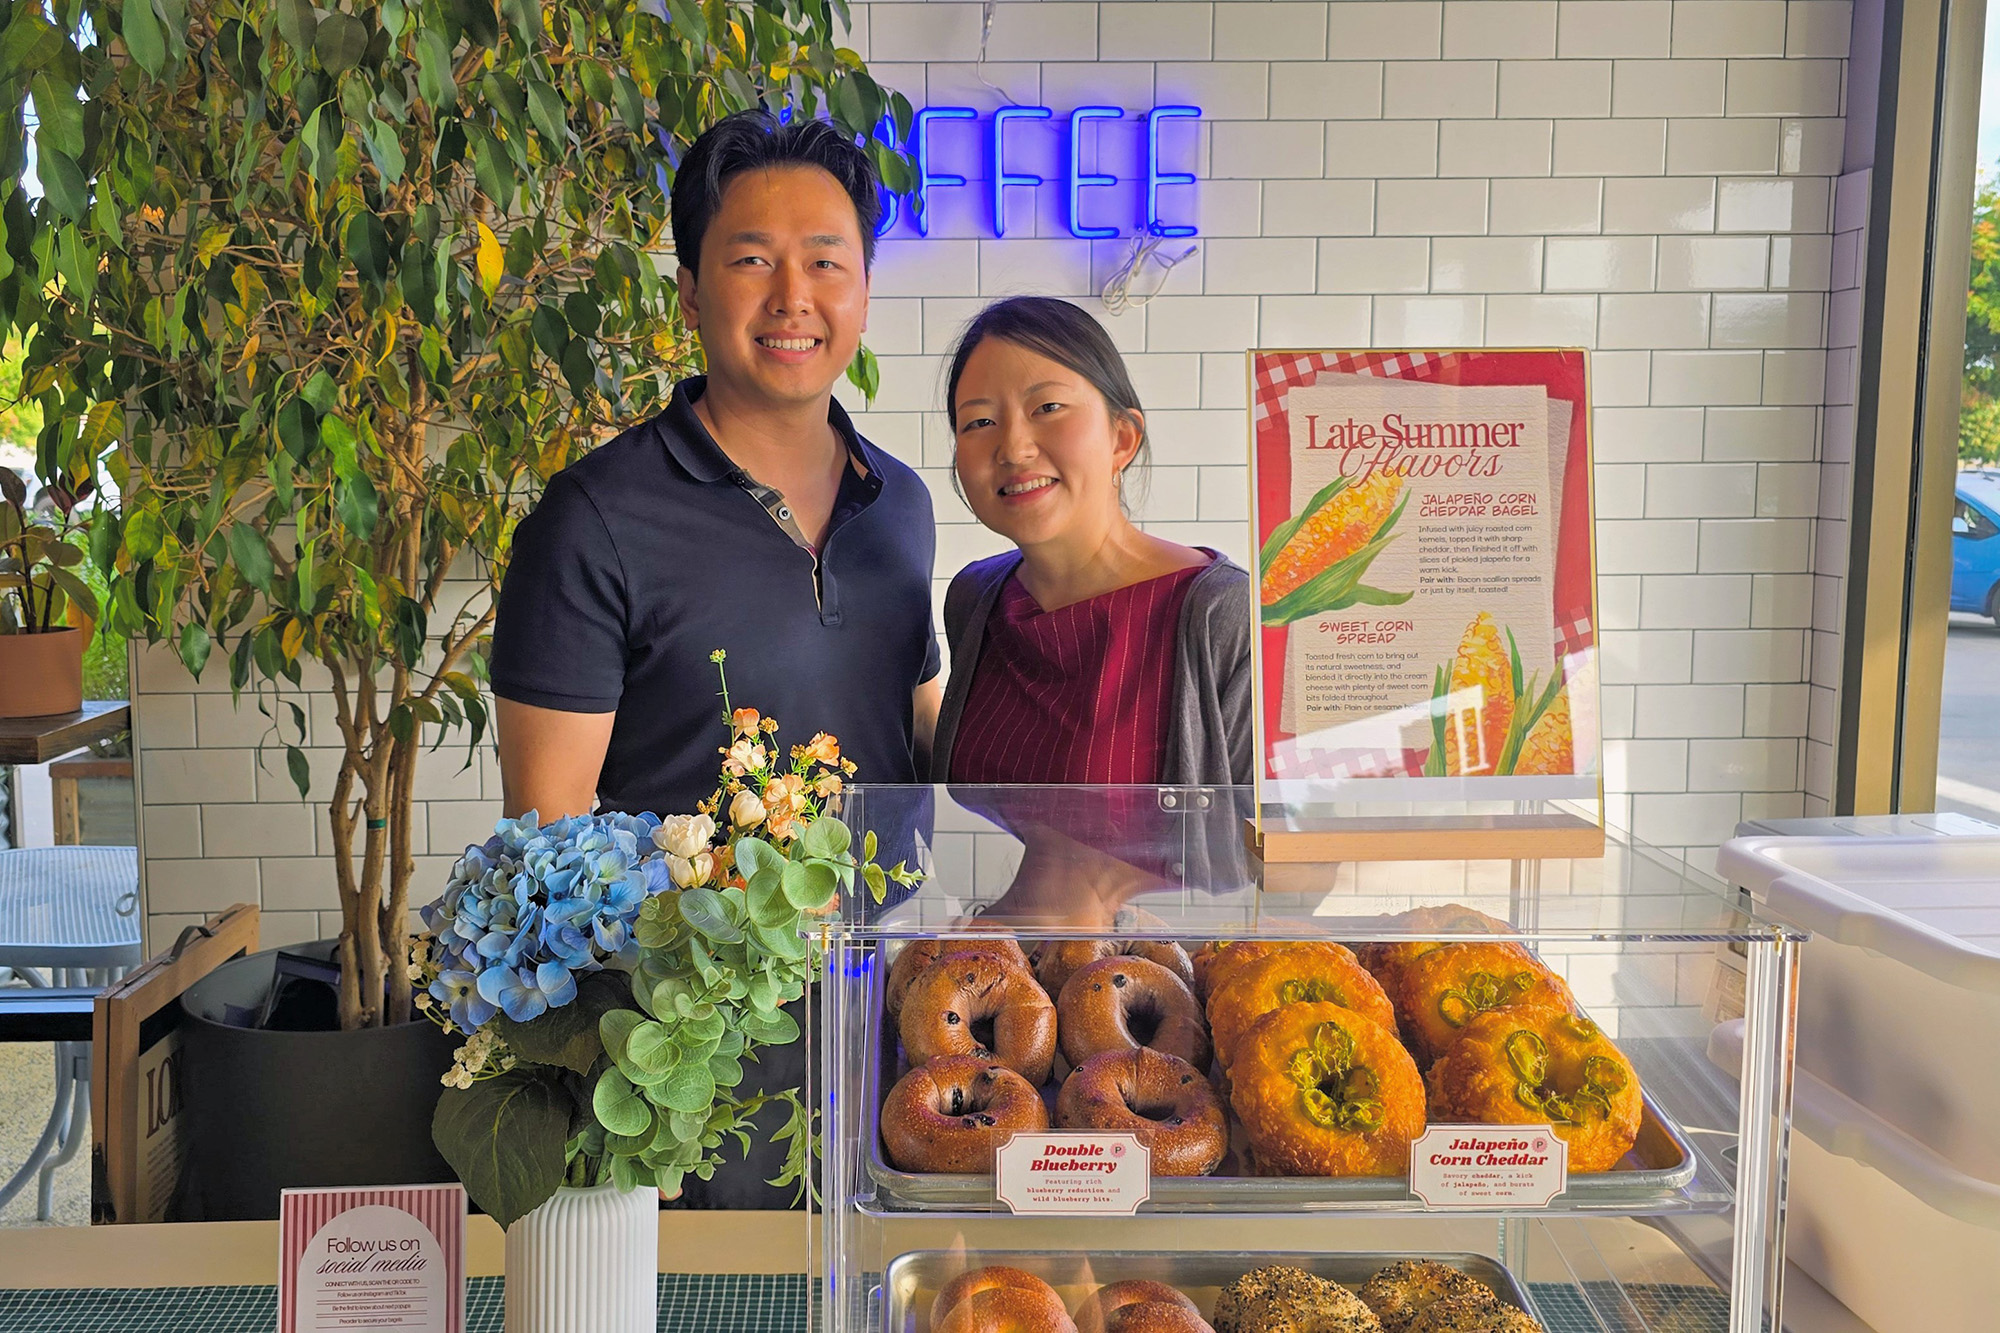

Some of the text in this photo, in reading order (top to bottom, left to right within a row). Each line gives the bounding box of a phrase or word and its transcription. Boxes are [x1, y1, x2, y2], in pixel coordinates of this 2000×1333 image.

[1305, 413, 1524, 450] Late Summer
[1339, 434, 1503, 488] Flavors
[1421, 493, 1537, 505] JALAPEÑO CORN
[1420, 505, 1539, 517] CHEDDAR BAGEL
[1466, 526, 1484, 536] juicy
[1449, 536, 1476, 544] topped
[1501, 535, 1523, 544] sharp
[1451, 556, 1478, 564] pickled
[1479, 555, 1510, 564] jalapeño
[1511, 575, 1542, 584] spreads
[1429, 587, 1444, 595] just
[1456, 586, 1477, 594] itself,
[1319, 621, 1414, 633] SWEET CORN
[1337, 633, 1396, 644] SPREAD
[1385, 652, 1405, 660] bring
[1344, 673, 1372, 681] directly
[1352, 684, 1375, 692] plenty
[1306, 704, 1322, 712] Pair
[1043, 1144, 1104, 1156] Double
[1449, 1136, 1528, 1153] Jalapeño
[1430, 1154, 1548, 1166] Corn Cheddar
[1030, 1159, 1117, 1174] Blueberry
[327, 1237, 420, 1253] Follow us on
[316, 1251, 428, 1275] social media
